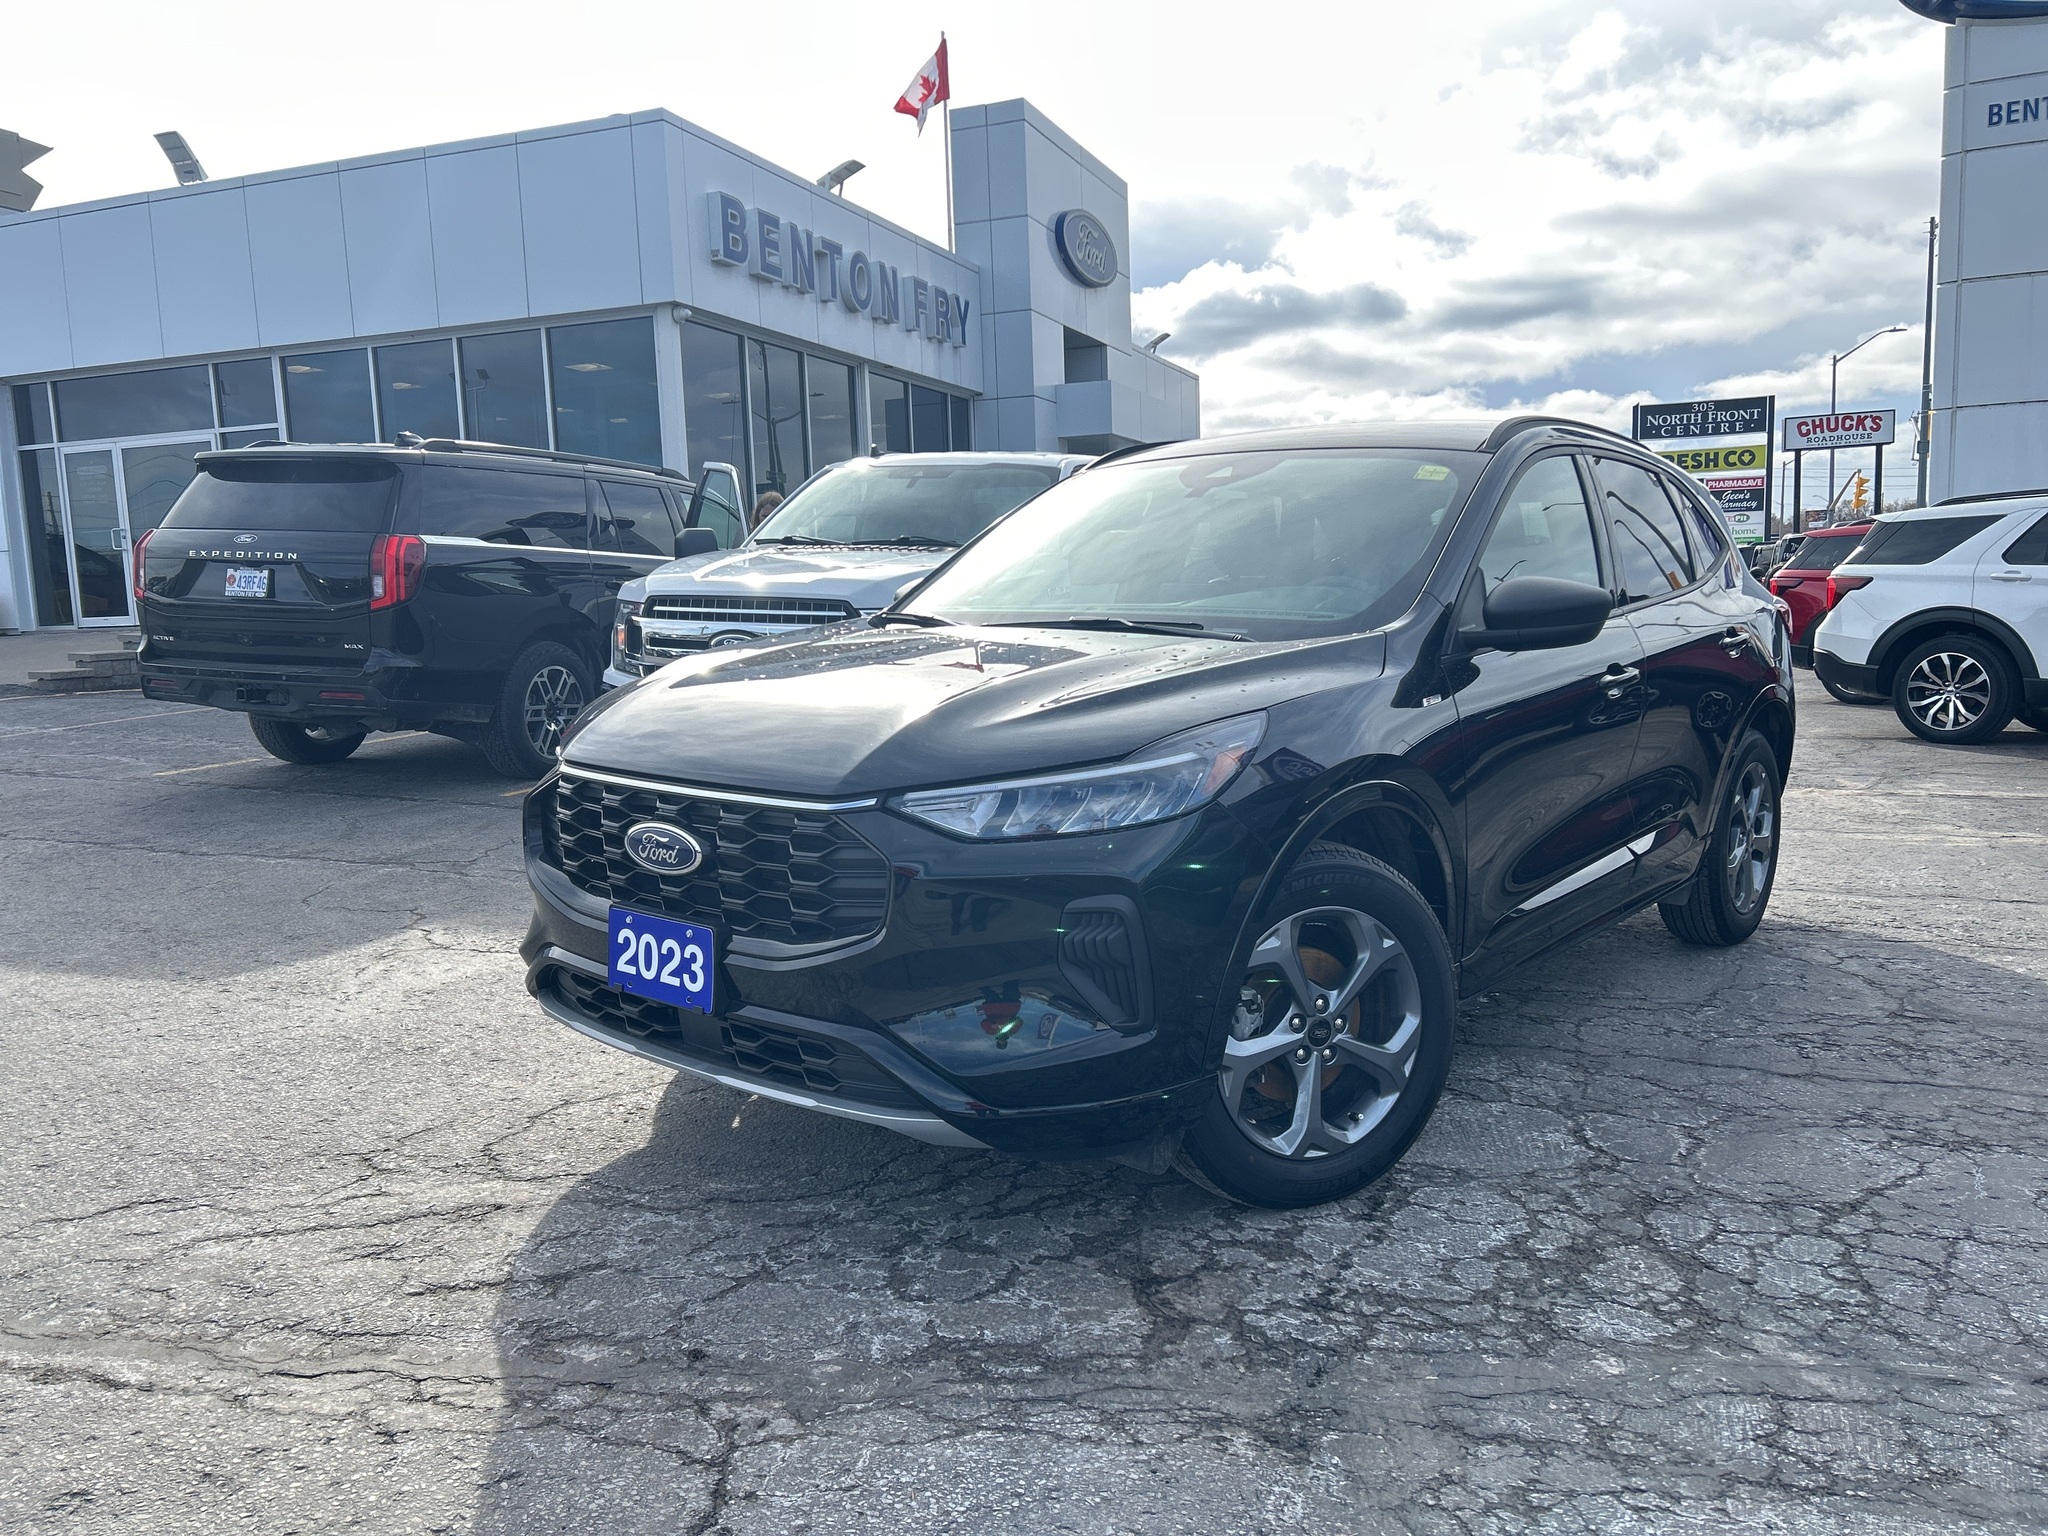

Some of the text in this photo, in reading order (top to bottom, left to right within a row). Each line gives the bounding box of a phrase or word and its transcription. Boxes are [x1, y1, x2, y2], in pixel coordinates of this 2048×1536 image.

[1077, 222, 1107, 276] Ford
[709, 191, 970, 348] BENTON FRY
[1691, 402, 1715, 412] 305
[1646, 408, 1761, 427] NORTH FRONT
[1661, 421, 1744, 437] CENTRE
[1796, 414, 1883, 438] CHUCK'S
[1806, 432, 1873, 444] ROADHOUSE
[1708, 478, 1762, 488] PHARMASAVE
[1719, 499, 1758, 509] harmacy
[189, 550, 298, 560] EXPEDITION
[236, 575, 267, 591] 43RF46
[638, 832, 680, 864] Ford
[616, 928, 705, 993] 2023
